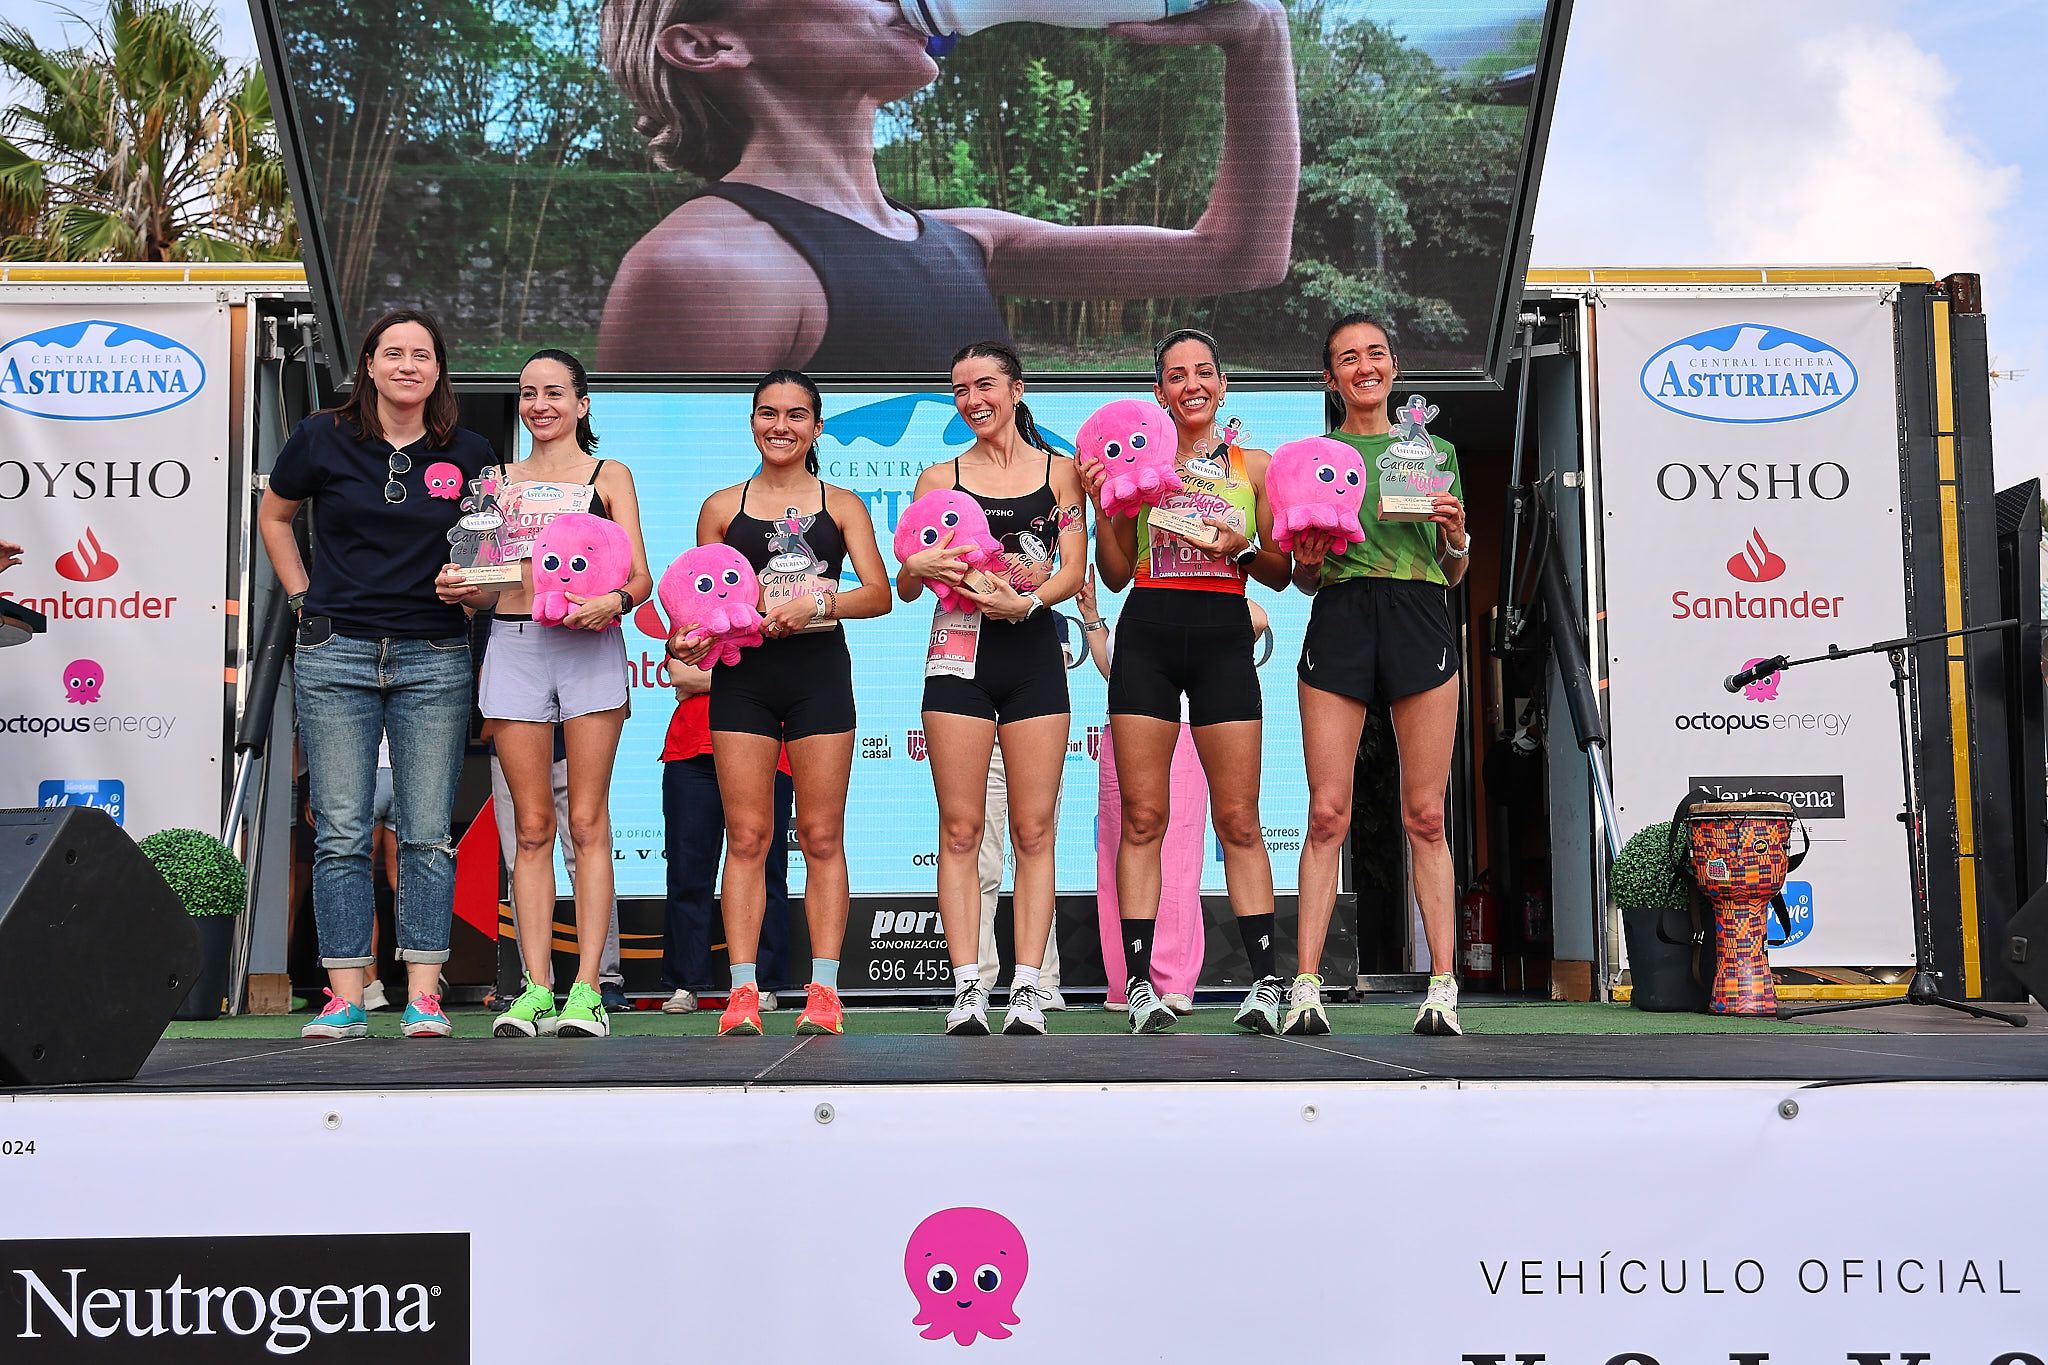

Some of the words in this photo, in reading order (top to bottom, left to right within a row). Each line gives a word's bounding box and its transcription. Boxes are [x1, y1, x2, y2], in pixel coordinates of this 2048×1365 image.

[31, 354, 103, 364] CENTRAL
[110, 354, 182, 364] LECHERA
[1689, 357, 1758, 368] CENTRAL
[1764, 357, 1834, 368] LECHERA
[0, 357, 189, 395] ASTURIANA
[1656, 360, 1843, 398] ASTURIANA
[1395, 446, 1428, 456] ASTURIANA
[829, 461, 937, 478] CENTRA
[1380, 457, 1425, 471] Carrera
[0, 460, 192, 499] OYSHO
[1386, 471, 1397, 482] de
[1399, 473, 1407, 483] la
[1405, 469, 1454, 495] Mujer
[1656, 461, 1850, 501] OYSHO
[984, 508, 1014, 517] OYSHO
[452, 531, 497, 543] Carrera
[774, 559, 808, 568] ASTURIANA
[762, 573, 807, 585] Carrera
[769, 586, 780, 598] de
[782, 585, 791, 597] la
[1671, 590, 1845, 620] Santander
[93, 715, 177, 739] energy
[1674, 711, 1770, 735] octopus
[1772, 712, 1853, 737] energy
[862, 746, 892, 759] casal
[627, 829, 663, 838] OFICIA
[1260, 826, 1300, 838] Correos
[869, 940, 948, 950] SONORIZACIO
[868, 959, 907, 981] 696
[912, 959, 951, 981] 455
[2, 1140, 37, 1155] 024
[1479, 1250, 1766, 1295] VEHÍCULO
[1797, 1258, 2022, 1295] OFICIAL
[12, 1268, 437, 1355] Neutrogena
